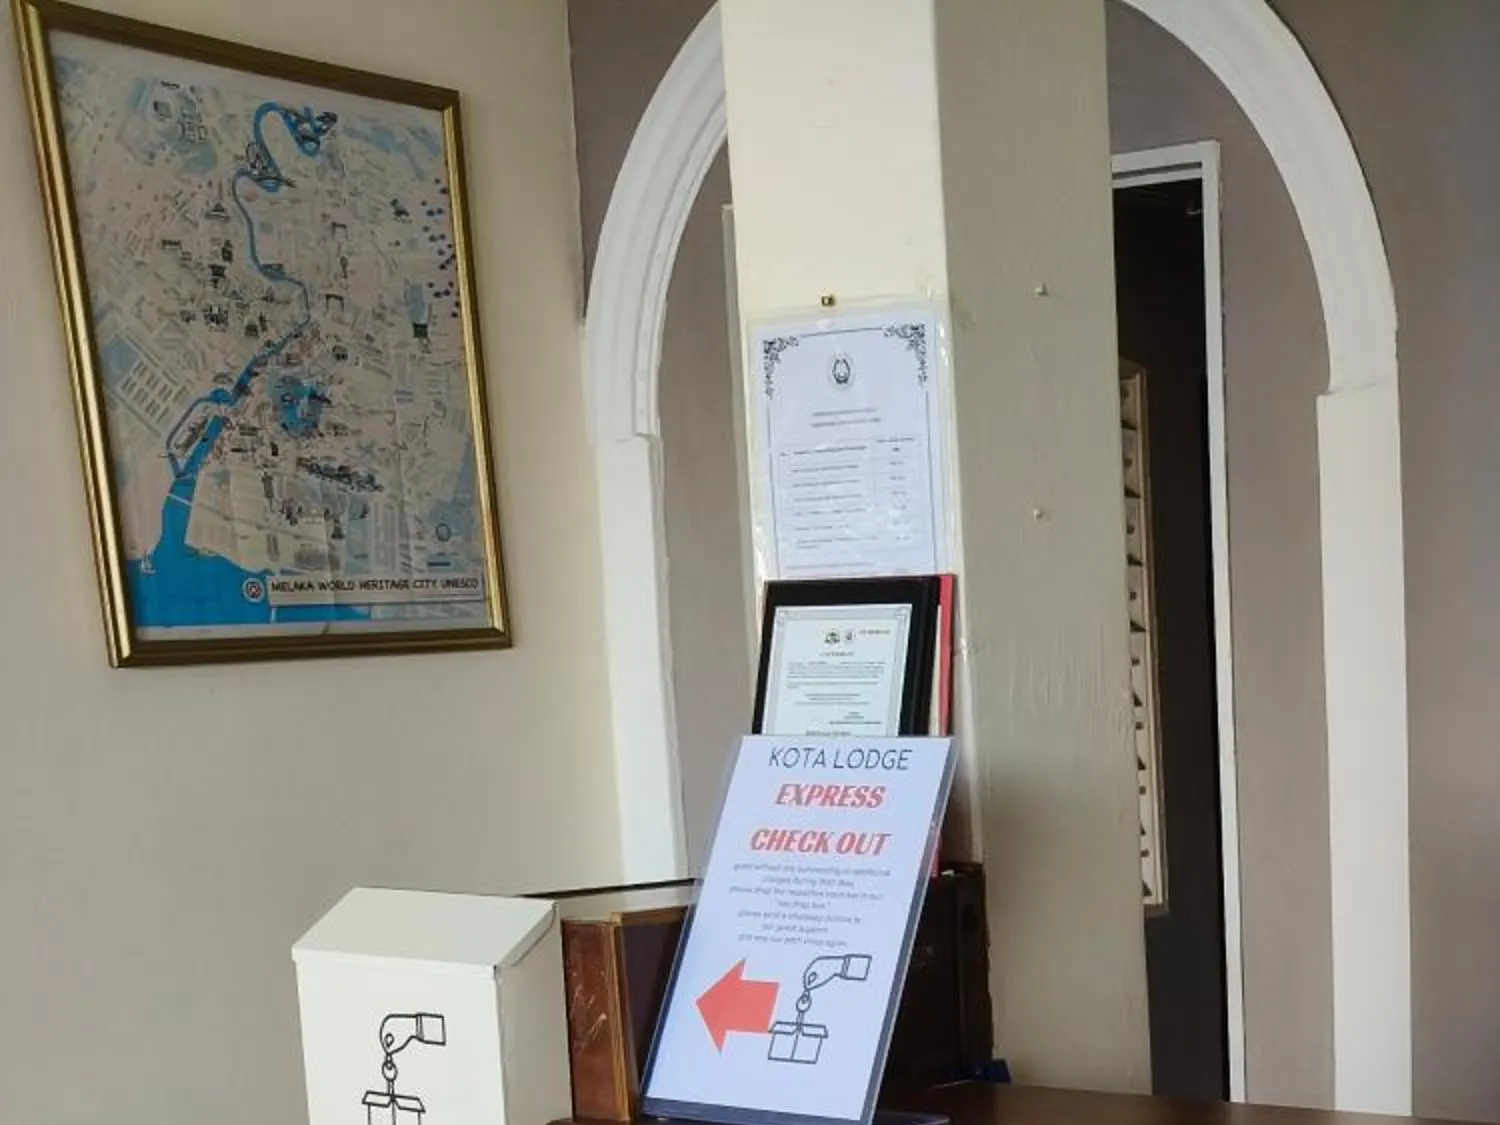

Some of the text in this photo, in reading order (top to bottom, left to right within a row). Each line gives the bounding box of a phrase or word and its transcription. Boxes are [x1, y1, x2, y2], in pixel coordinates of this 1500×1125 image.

[271, 577, 479, 592] MELAKA WORLD HERITAGE CITY UNESCO
[768, 747, 913, 770] KOTA LODGE
[775, 783, 887, 808] EXPRESS
[750, 828, 892, 856] CHECK OUT
